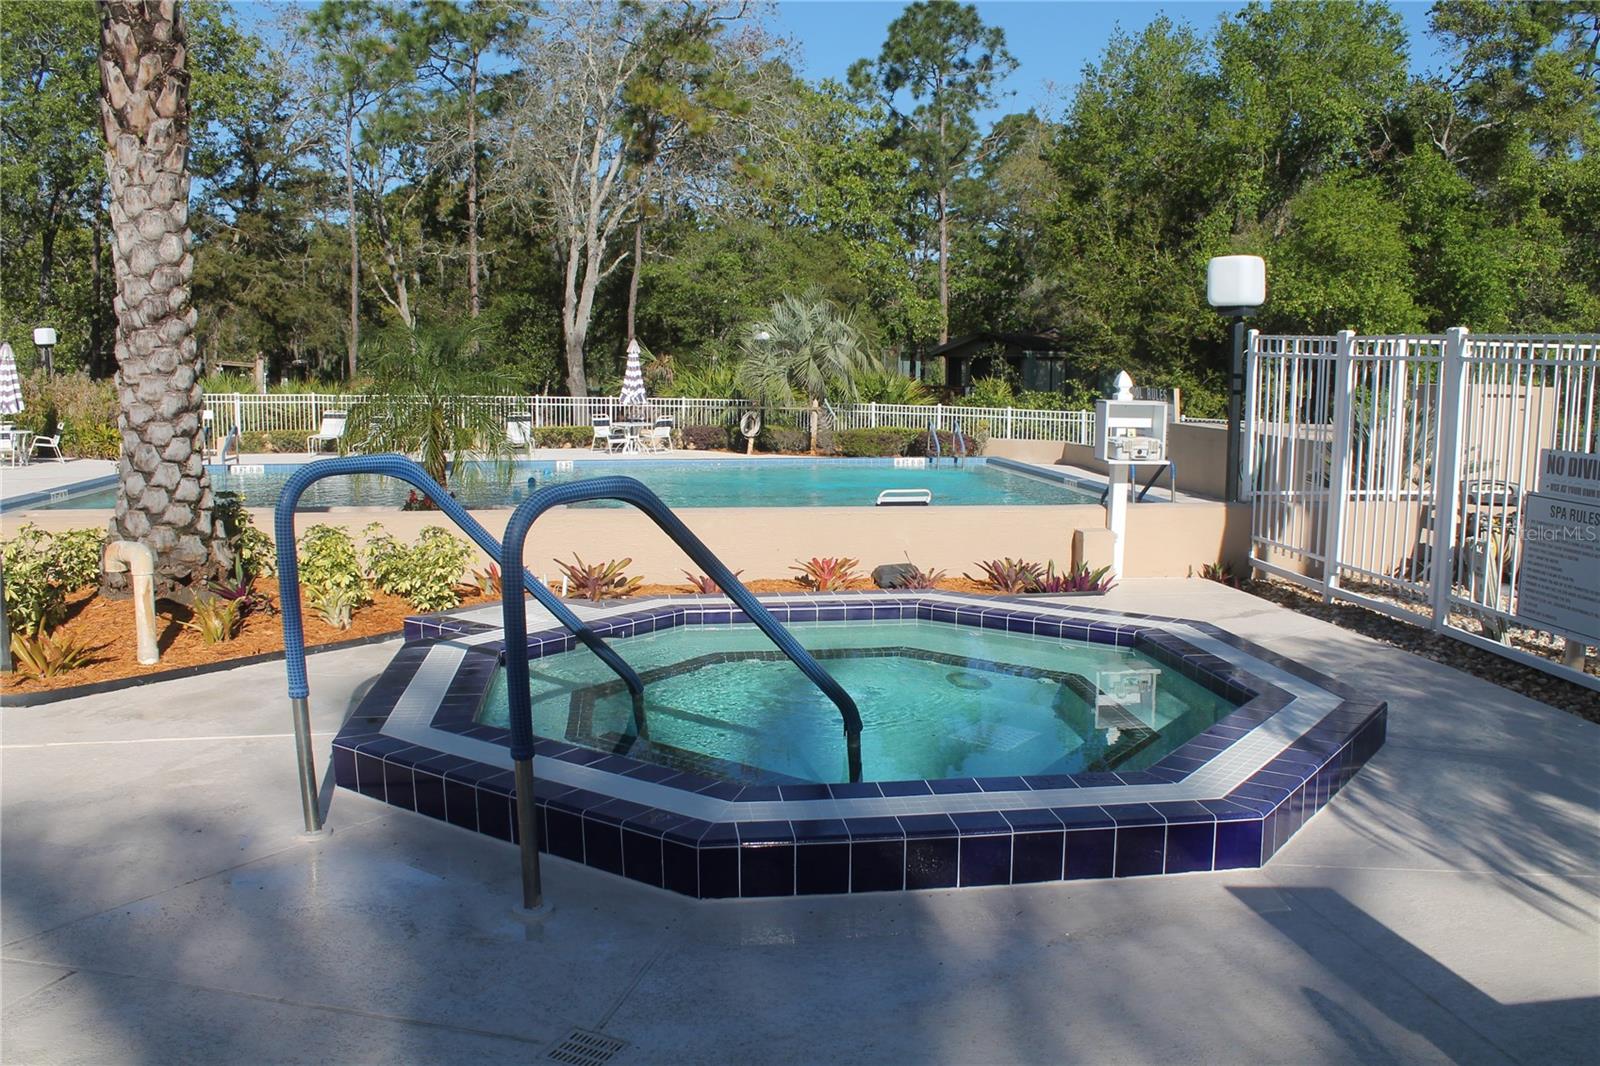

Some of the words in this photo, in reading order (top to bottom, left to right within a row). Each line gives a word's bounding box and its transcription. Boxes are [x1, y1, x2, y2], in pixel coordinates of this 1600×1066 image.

[1147, 387, 1168, 401] RULES
[1546, 454, 1565, 476] NO
[1550, 505, 1566, 520] SPA
[1569, 509, 1600, 526] RULES
